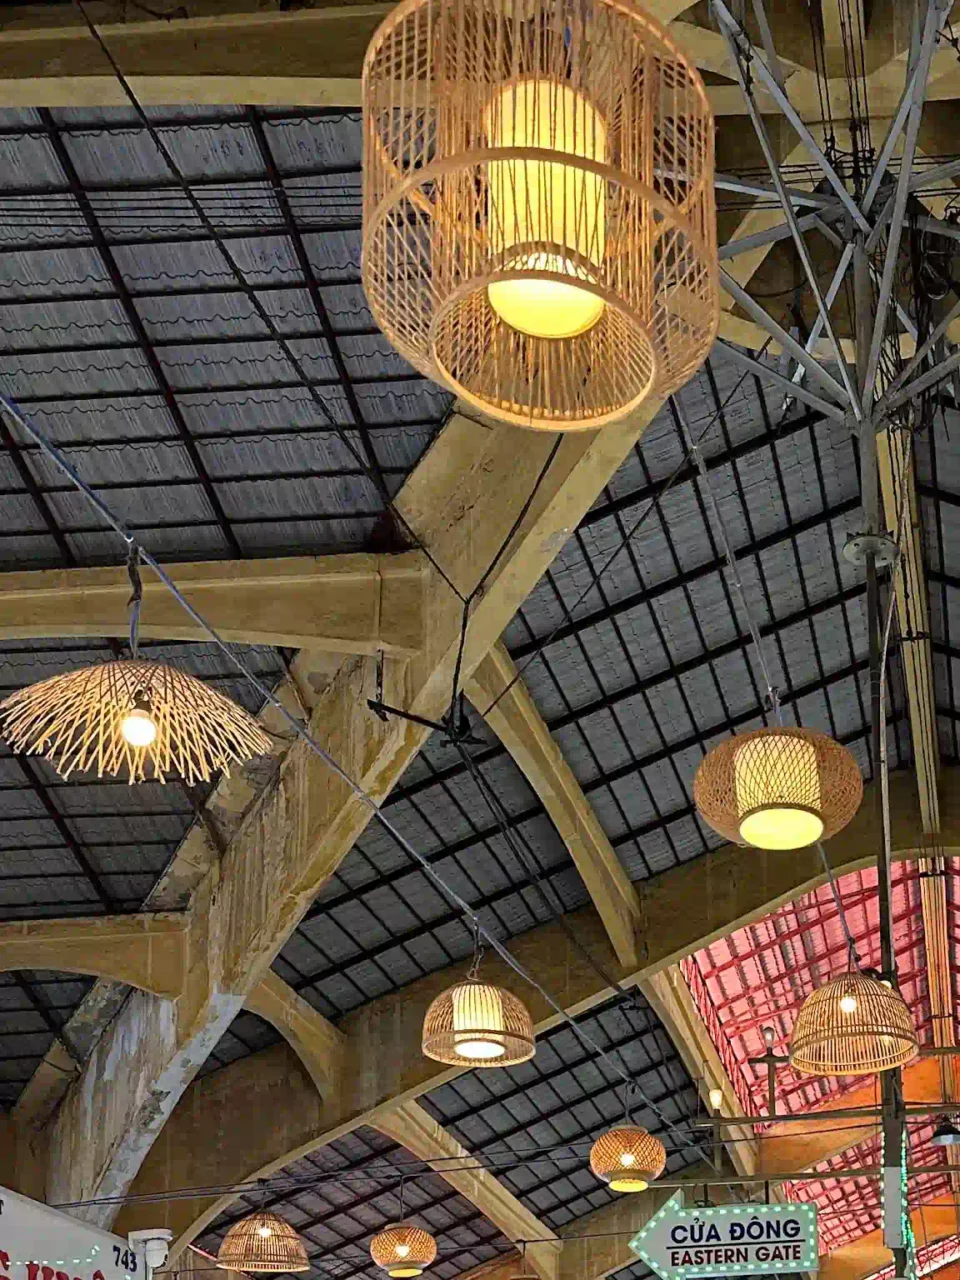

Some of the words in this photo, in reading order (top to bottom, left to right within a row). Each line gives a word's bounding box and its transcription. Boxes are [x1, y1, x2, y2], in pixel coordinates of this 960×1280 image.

[671, 1218, 721, 1243] CỬA
[729, 1216, 800, 1240] ĐÔNG
[113, 1245, 137, 1272] 743
[671, 1248, 748, 1267] EASTERN
[756, 1245, 801, 1261] GATE
